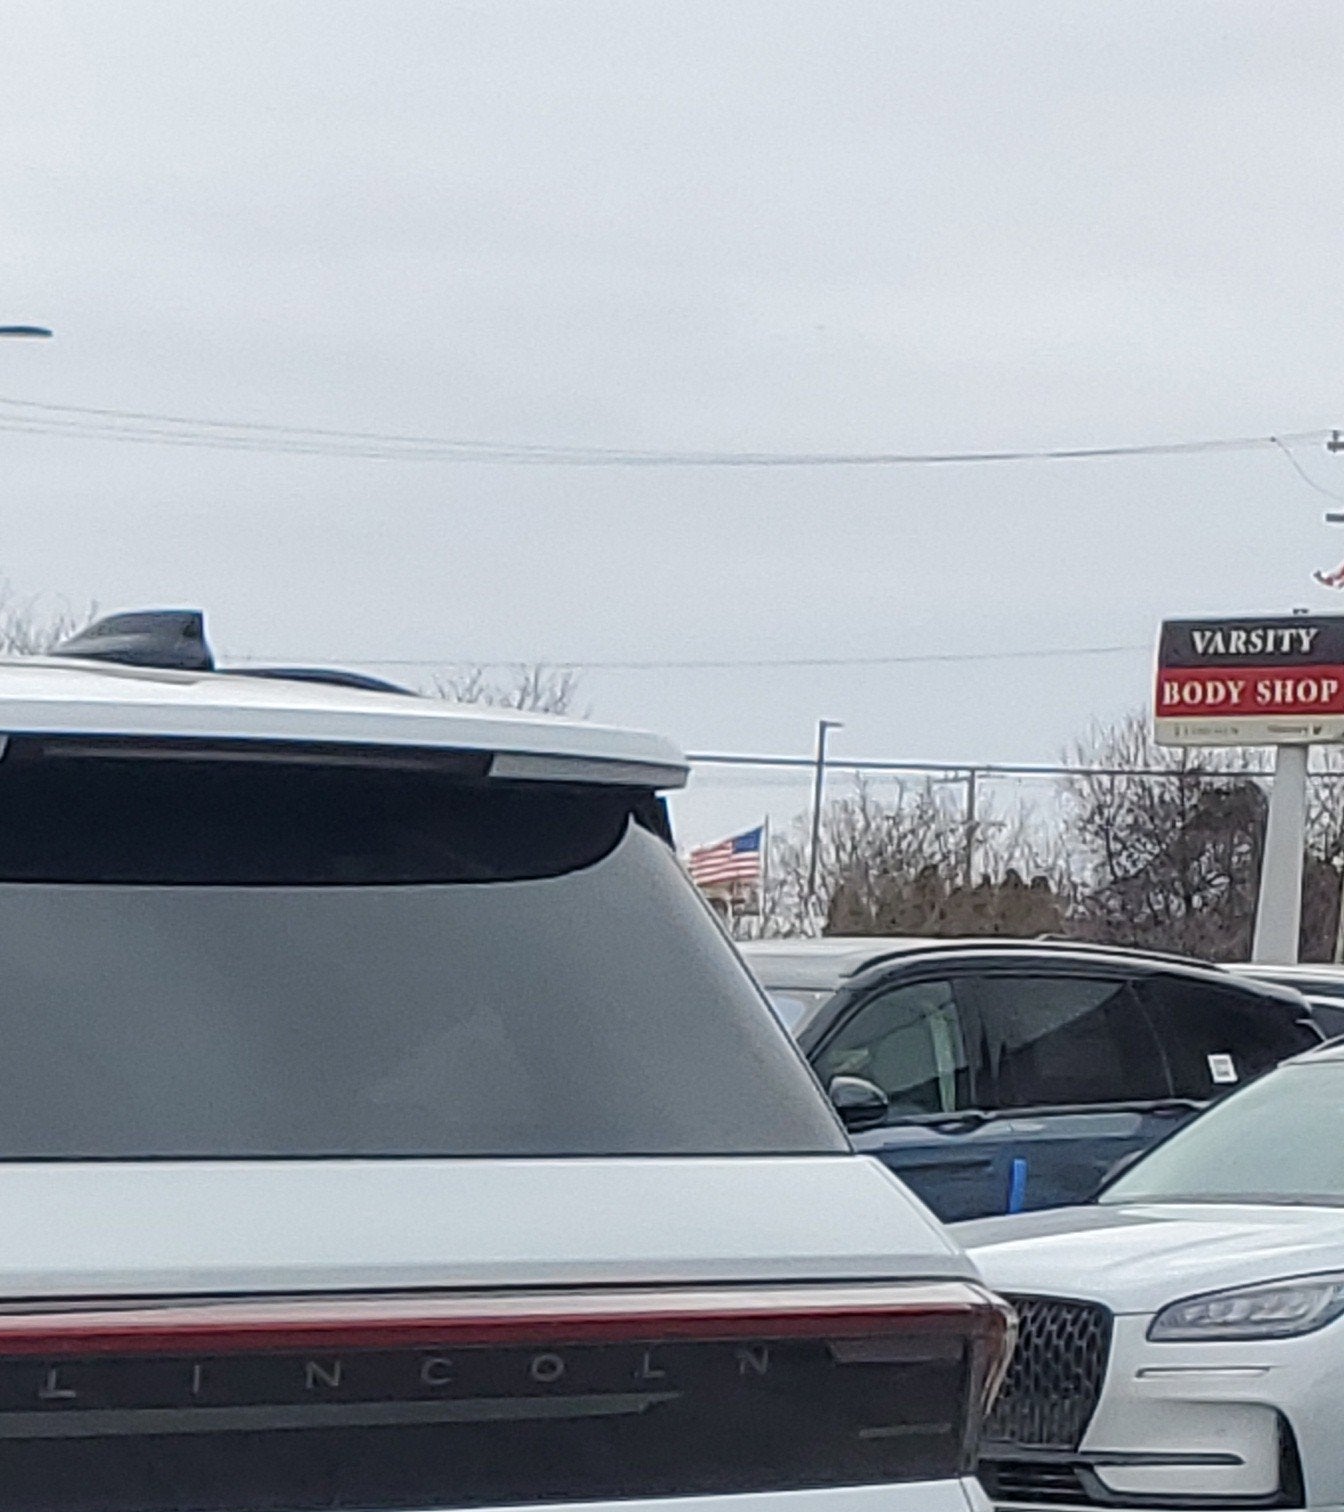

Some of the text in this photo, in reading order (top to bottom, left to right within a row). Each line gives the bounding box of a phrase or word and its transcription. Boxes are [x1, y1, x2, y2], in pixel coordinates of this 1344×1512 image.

[1192, 628, 1318, 654] VARSITY
[1162, 679, 1339, 705] BODY SHOP
[44, 1346, 769, 1398] LINCOLN
